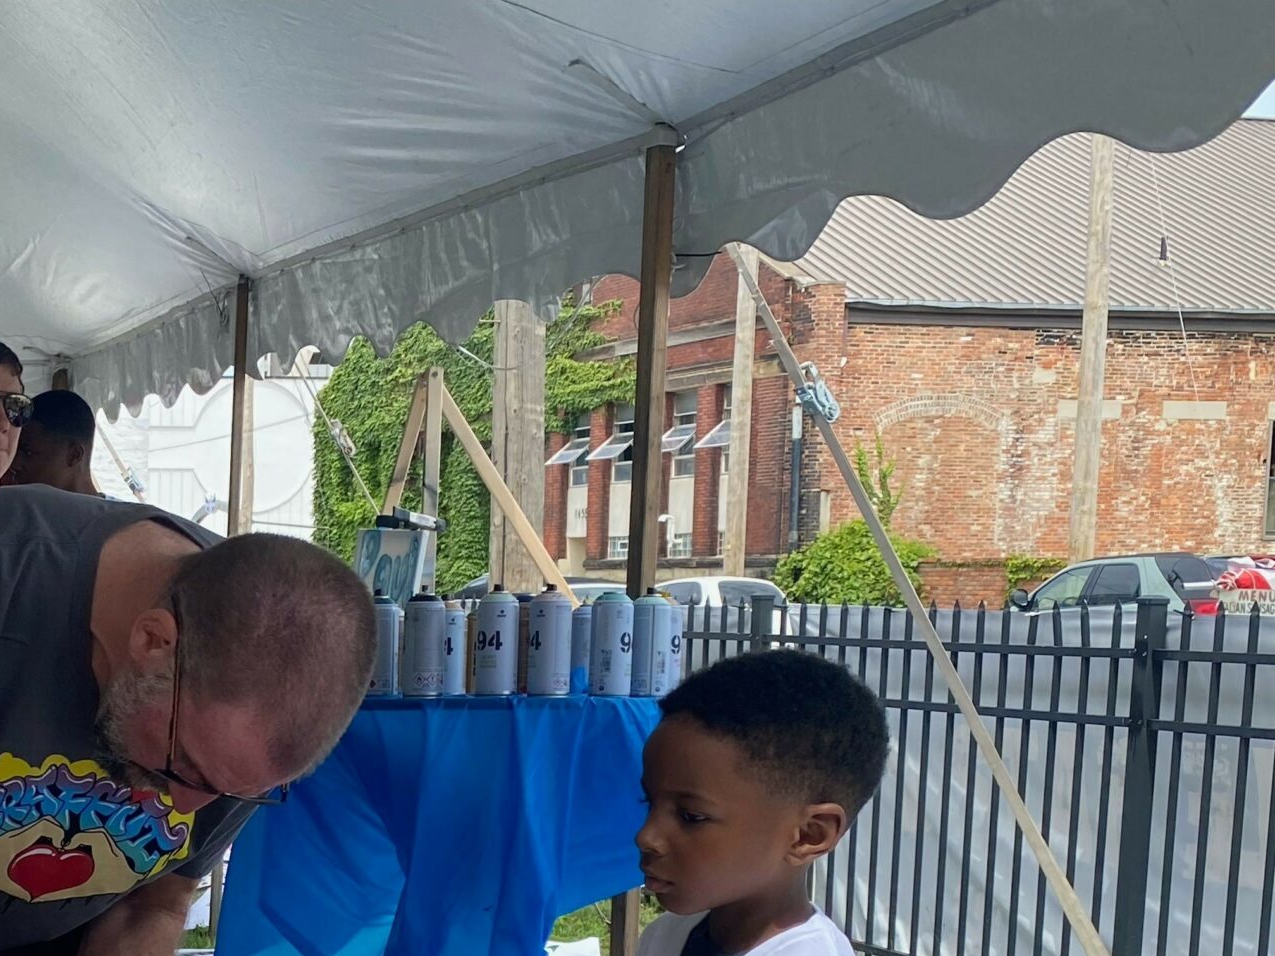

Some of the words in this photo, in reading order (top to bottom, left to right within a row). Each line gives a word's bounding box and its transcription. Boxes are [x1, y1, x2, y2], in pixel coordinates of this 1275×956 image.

[477, 630, 503, 651] 94
[620, 631, 632, 653] 9
[671, 634, 681, 655] 9
